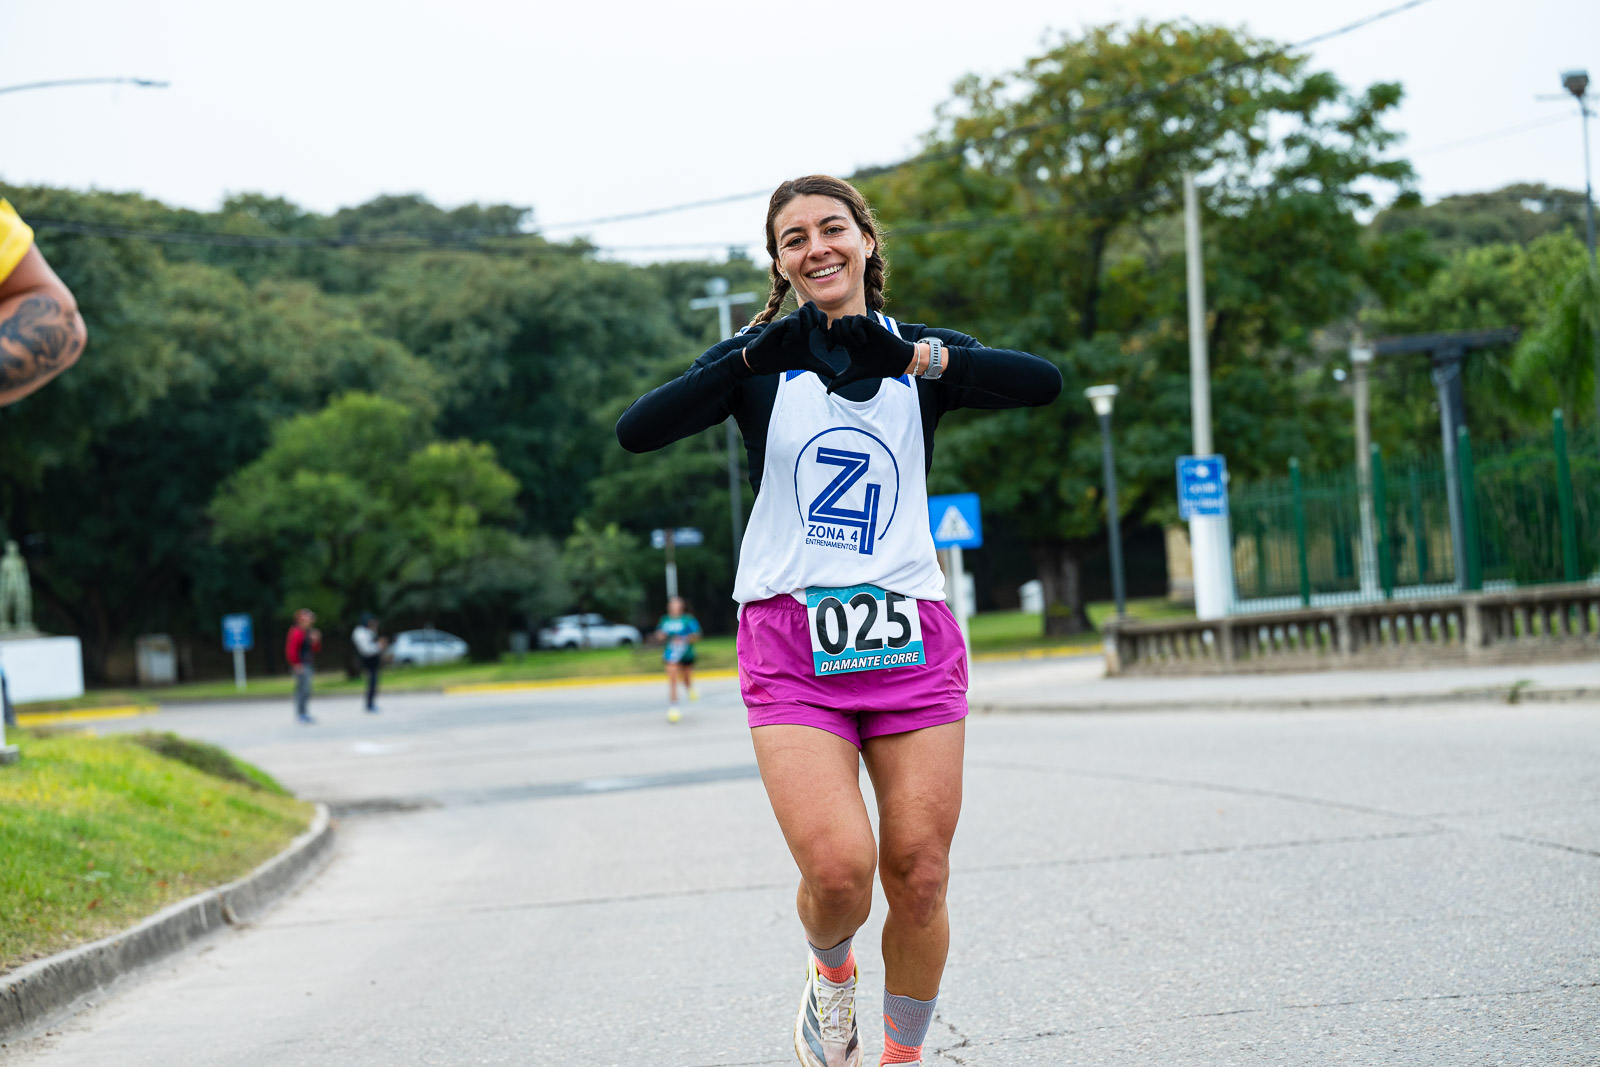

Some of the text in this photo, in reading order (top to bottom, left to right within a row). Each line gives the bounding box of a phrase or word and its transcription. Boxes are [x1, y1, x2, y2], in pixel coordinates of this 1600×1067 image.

[807, 524, 858, 542] ZONA 4
[805, 537, 858, 551] ENTRENAMIENTOS
[816, 591, 912, 656] 025
[820, 651, 920, 673] DIAMANTE CORRE
